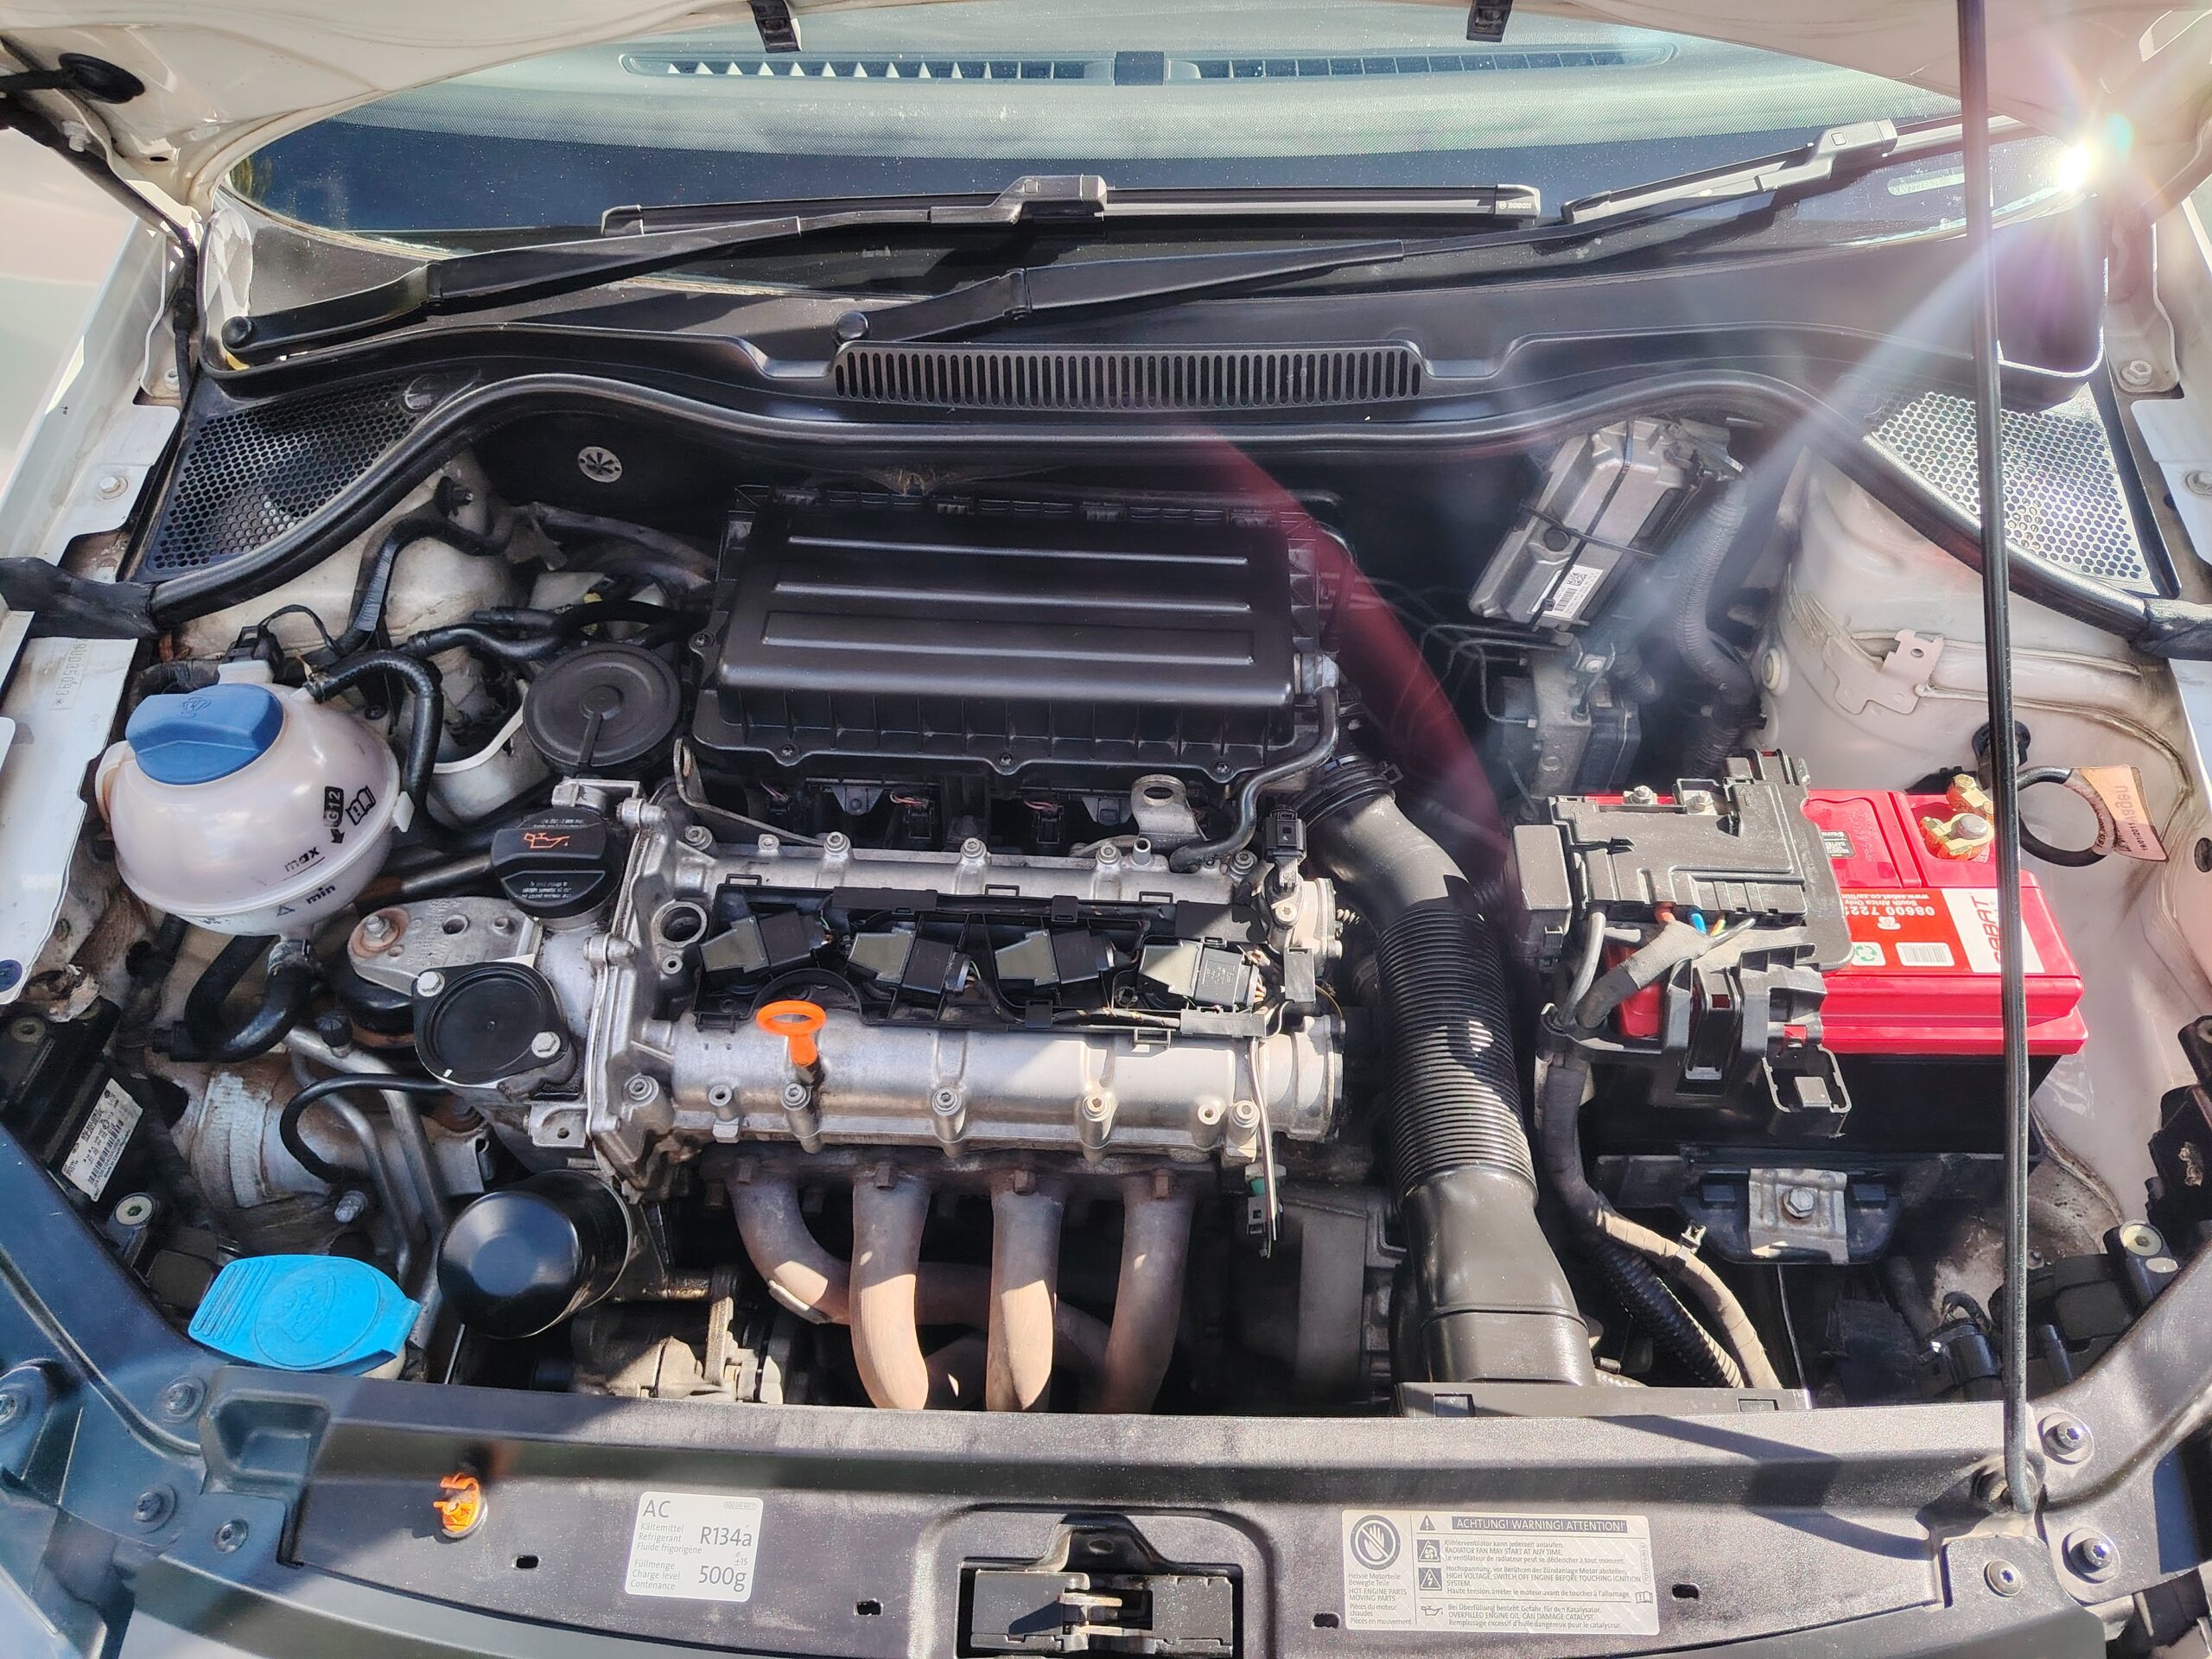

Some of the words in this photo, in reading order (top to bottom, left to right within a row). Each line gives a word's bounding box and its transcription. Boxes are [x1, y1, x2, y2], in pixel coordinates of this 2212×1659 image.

[327, 791, 340, 820] G12
[284, 847, 320, 872] max
[306, 884, 336, 904] min
[1885, 906, 1936, 916] 08600
[642, 1499, 671, 1518] AC
[640, 1522, 683, 1533] Kältemittel
[1456, 1518, 1509, 1529] ACHTUNG!
[1511, 1519, 1563, 1530] WARNING!
[1566, 1521, 1624, 1532] ATTENTION!
[639, 1532, 682, 1543] Refrigerant
[700, 1526, 753, 1548] R134a
[637, 1542, 659, 1552] Fluide
[661, 1544, 702, 1556] frigorigène
[634, 1559, 675, 1570] Füllmenge
[632, 1568, 660, 1580] Charge
[662, 1571, 681, 1580] level
[698, 1565, 747, 1592] 500g
[631, 1580, 676, 1591] Contenance
[1449, 1619, 1485, 1628] Remplissage
